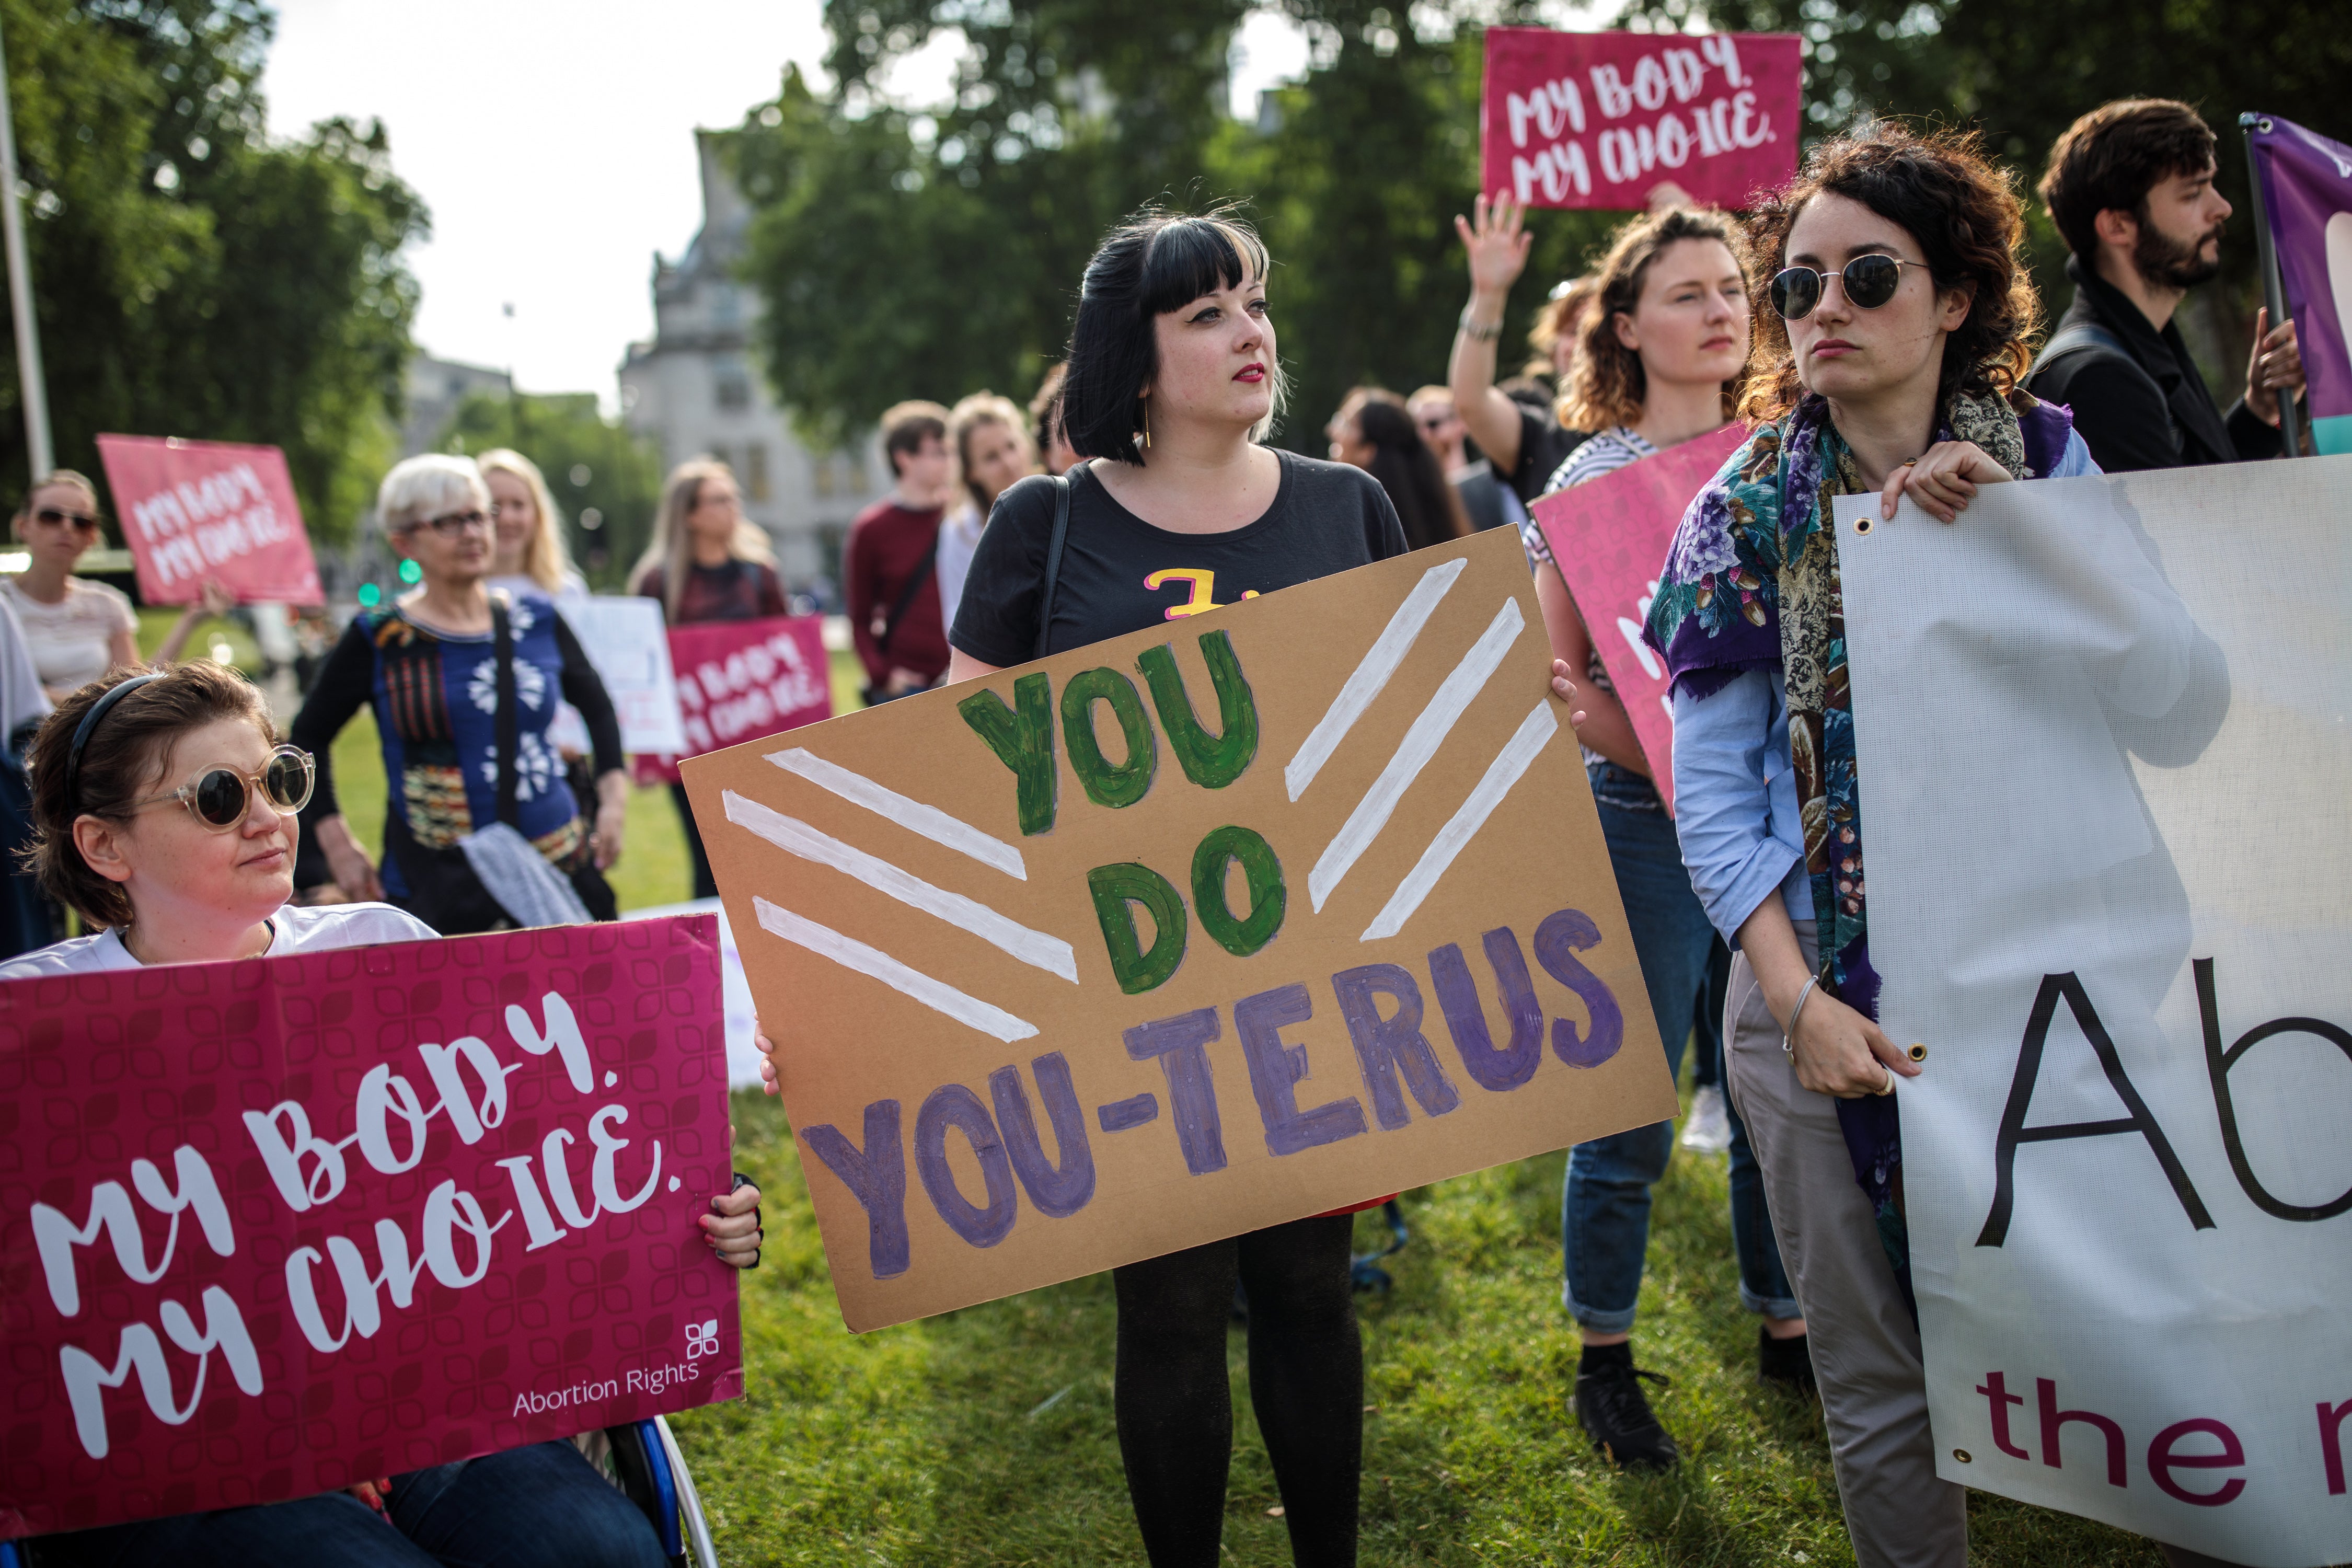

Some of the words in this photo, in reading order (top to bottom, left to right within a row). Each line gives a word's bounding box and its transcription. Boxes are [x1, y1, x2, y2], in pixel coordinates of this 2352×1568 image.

[1507, 76, 1586, 148] MY
[1589, 33, 1754, 119] BODY.
[1512, 141, 1591, 203] MY
[1598, 90, 1777, 184] CHOICE.
[957, 629, 1259, 836] YOU
[1087, 824, 1286, 995] DO
[30, 1144, 235, 1317] MY
[242, 991, 618, 1213] BODY.
[800, 908, 1624, 1280] YOU-TERUS
[59, 1285, 264, 1459] MY
[285, 1104, 681, 1353] CHOICE.
[513, 1380, 618, 1417] Abortion
[627, 1362, 699, 1395] Rights
[1976, 1371, 2247, 1507] the
